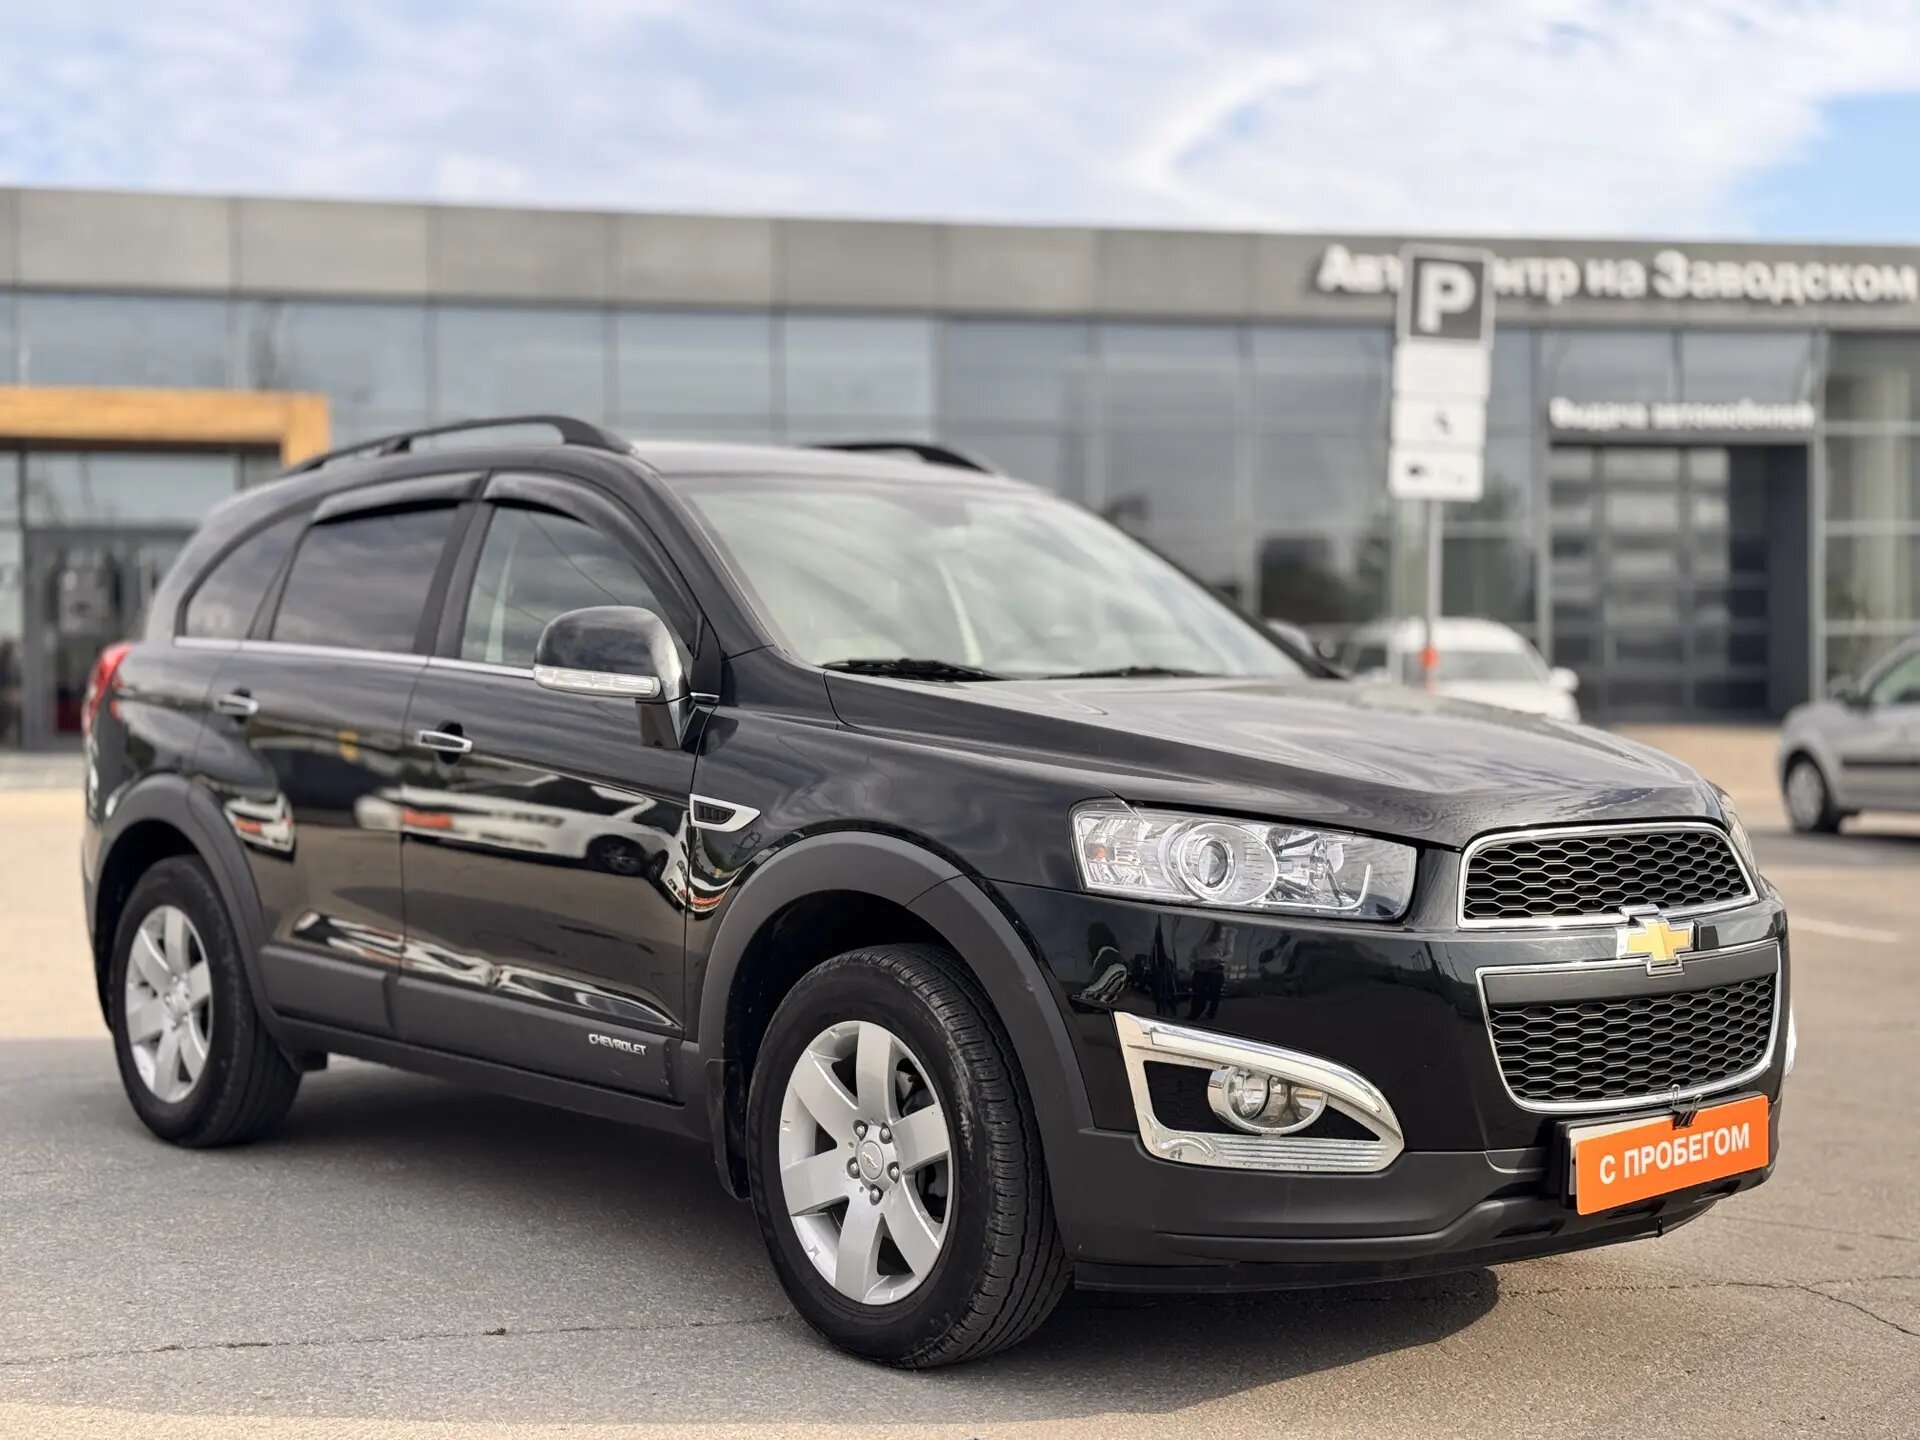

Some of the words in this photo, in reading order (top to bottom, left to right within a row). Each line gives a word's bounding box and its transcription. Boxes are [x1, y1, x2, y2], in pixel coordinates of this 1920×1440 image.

[1417, 261, 1477, 334] P
[1585, 257, 1647, 299] на
[1652, 249, 1918, 306] Заводском
[588, 1033, 647, 1056] CHEVROLET
[1599, 1154, 1617, 1185] С
[1624, 1121, 1750, 1179] ПРОБЕГОМ
